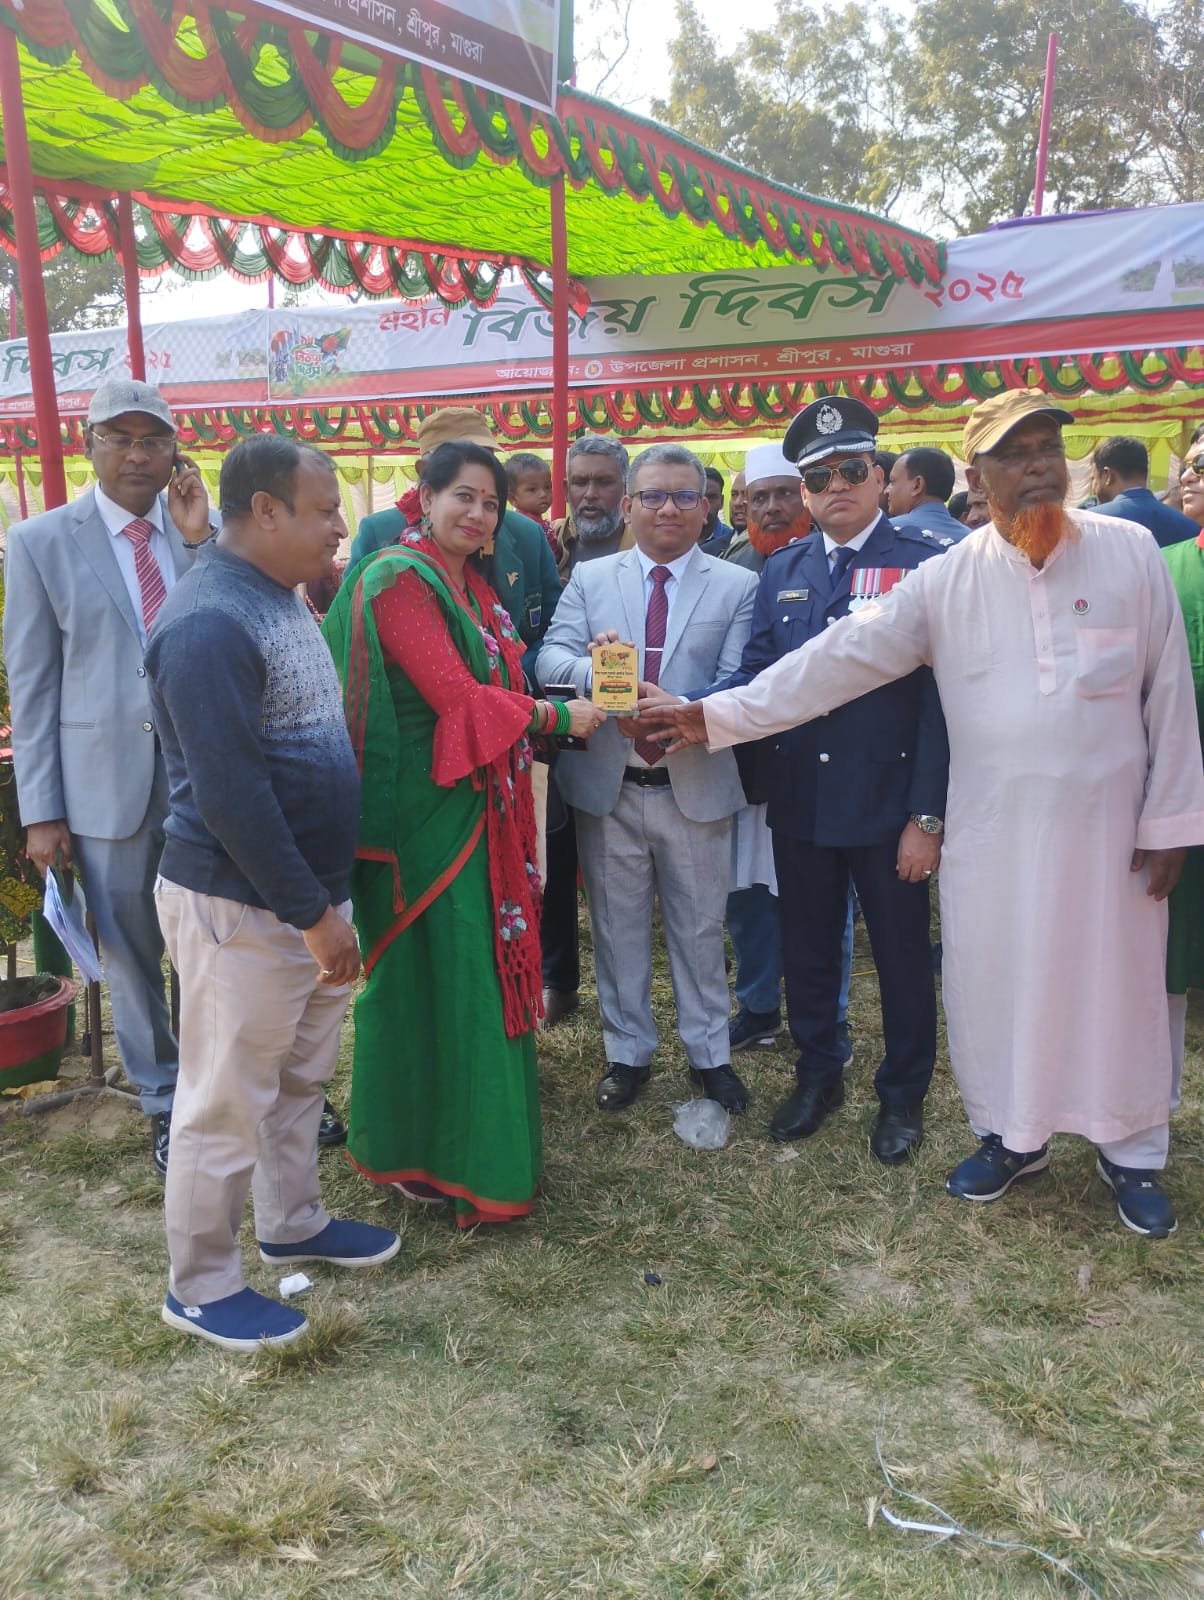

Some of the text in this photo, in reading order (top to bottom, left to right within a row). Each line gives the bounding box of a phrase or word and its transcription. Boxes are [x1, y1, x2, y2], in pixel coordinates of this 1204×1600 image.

[450, 31, 484, 64] মাগুরা
[378, 306, 451, 332] মহান
[679, 274, 899, 329] দিবস
[609, 358, 687, 374] উপজেলা
[852, 342, 914, 359] মাগুরা
